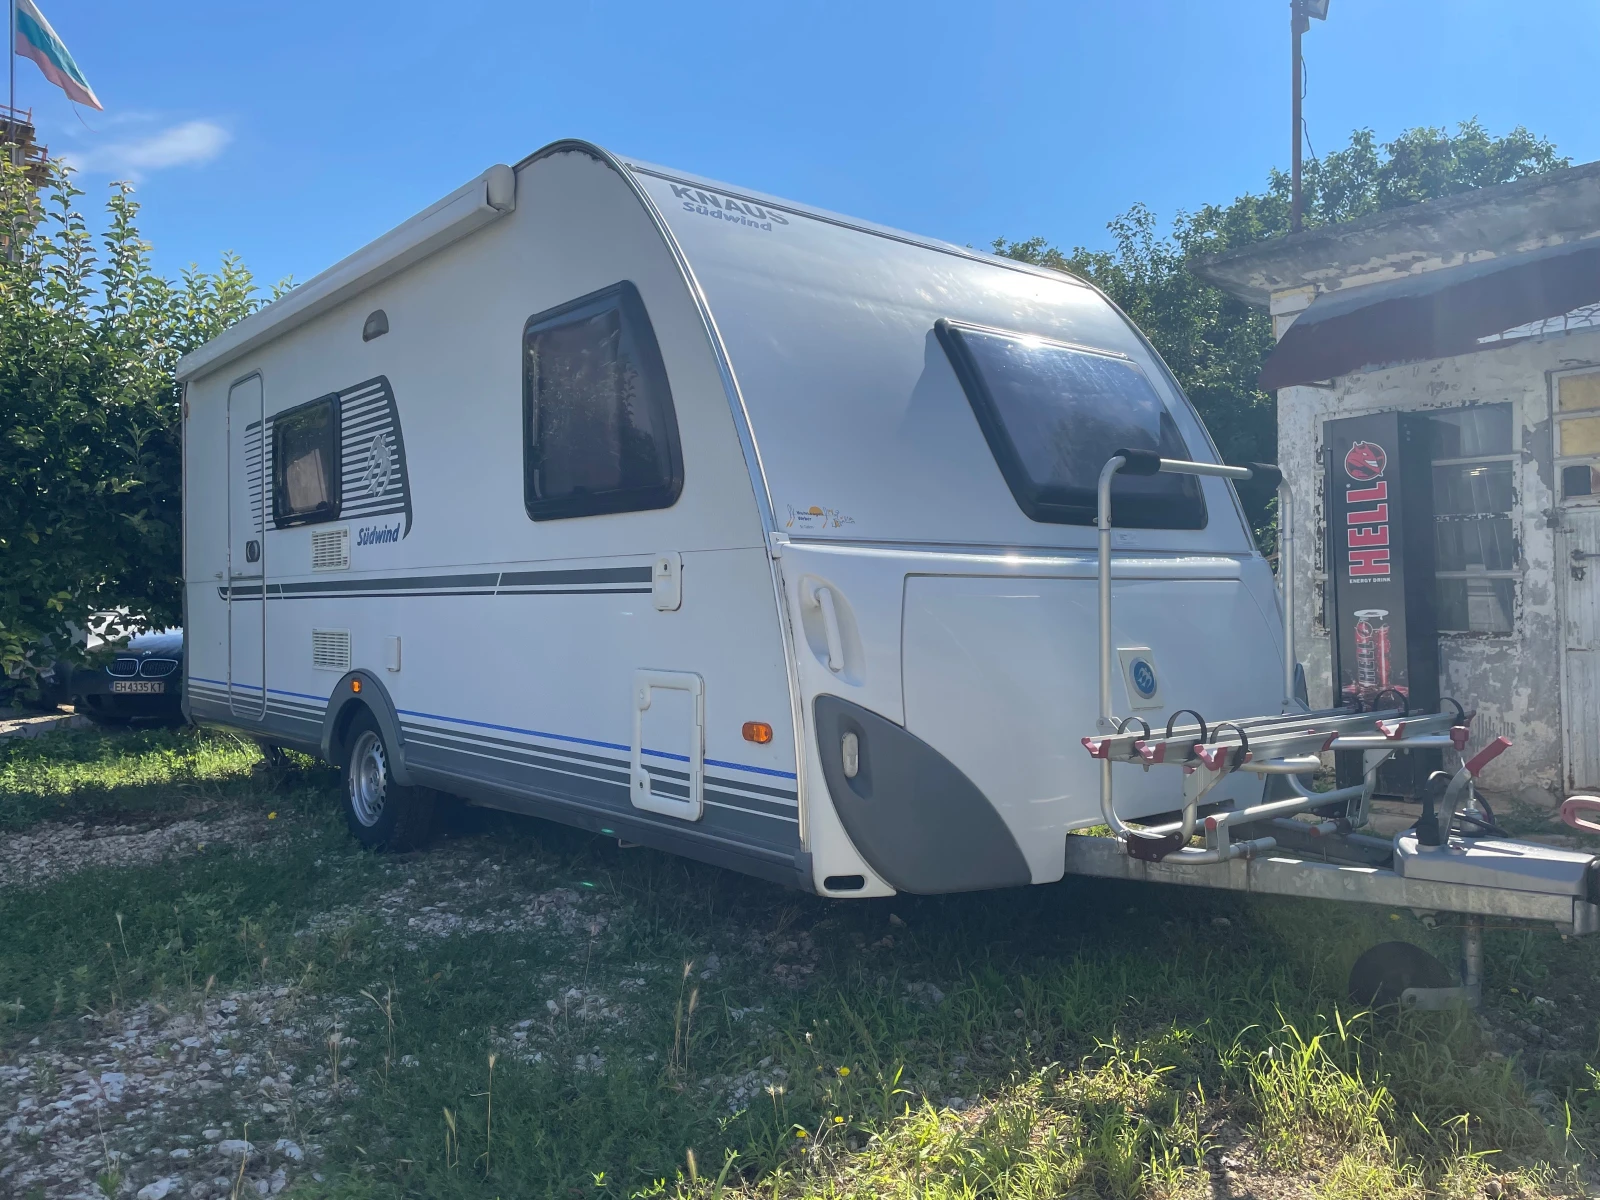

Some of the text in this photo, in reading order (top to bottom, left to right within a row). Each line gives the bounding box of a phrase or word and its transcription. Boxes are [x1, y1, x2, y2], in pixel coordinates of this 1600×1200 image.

[669, 183, 790, 226] KNAUS
[682, 201, 772, 232] Südwind
[357, 522, 401, 547] Südwind
[1346, 480, 1391, 577] HELL
[114, 682, 163, 692] EH 4335 KT
